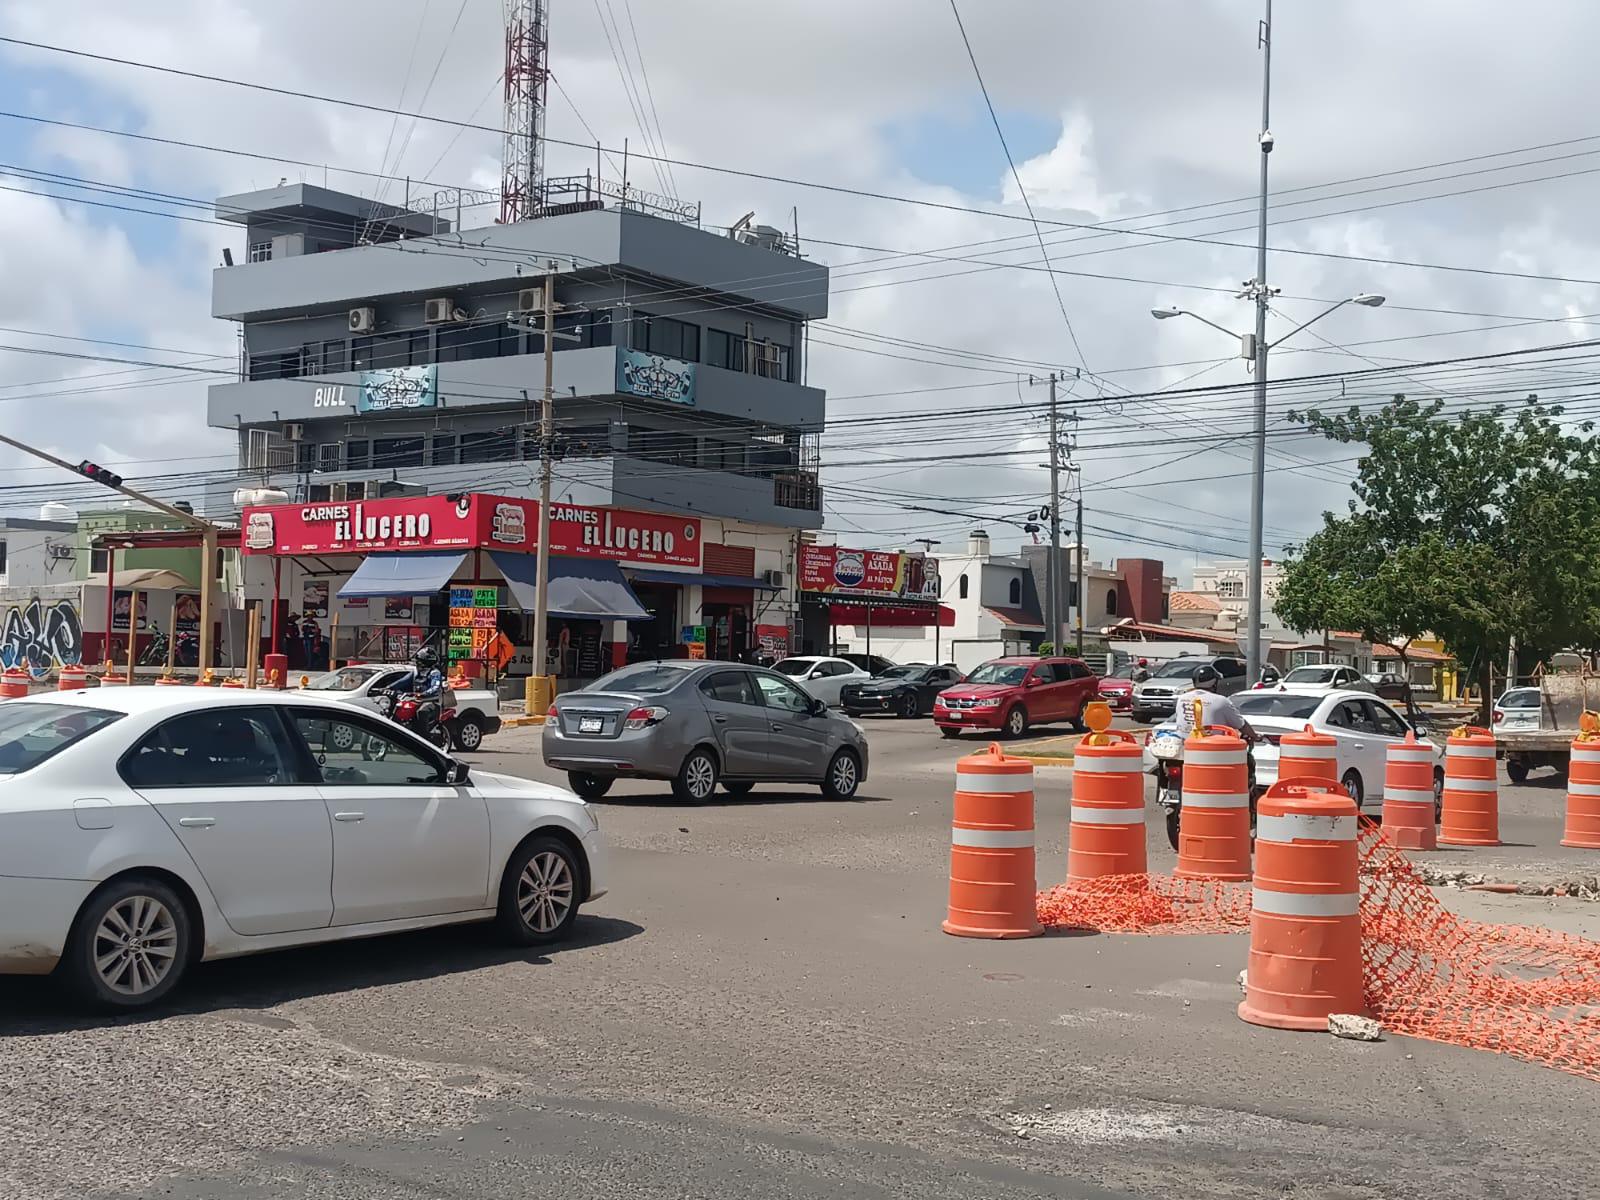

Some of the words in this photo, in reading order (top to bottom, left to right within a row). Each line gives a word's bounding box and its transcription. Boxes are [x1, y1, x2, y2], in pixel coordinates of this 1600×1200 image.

[314, 386, 346, 408] BULL
[302, 506, 349, 521] CARNES
[335, 521, 351, 540] EL
[355, 503, 429, 540] LUCERO
[548, 506, 598, 523] CARNES
[584, 525, 600, 545] EL
[604, 512, 674, 554] LUCERO
[867, 561, 893, 571] ASADA
[475, 609, 495, 618] ASADA
